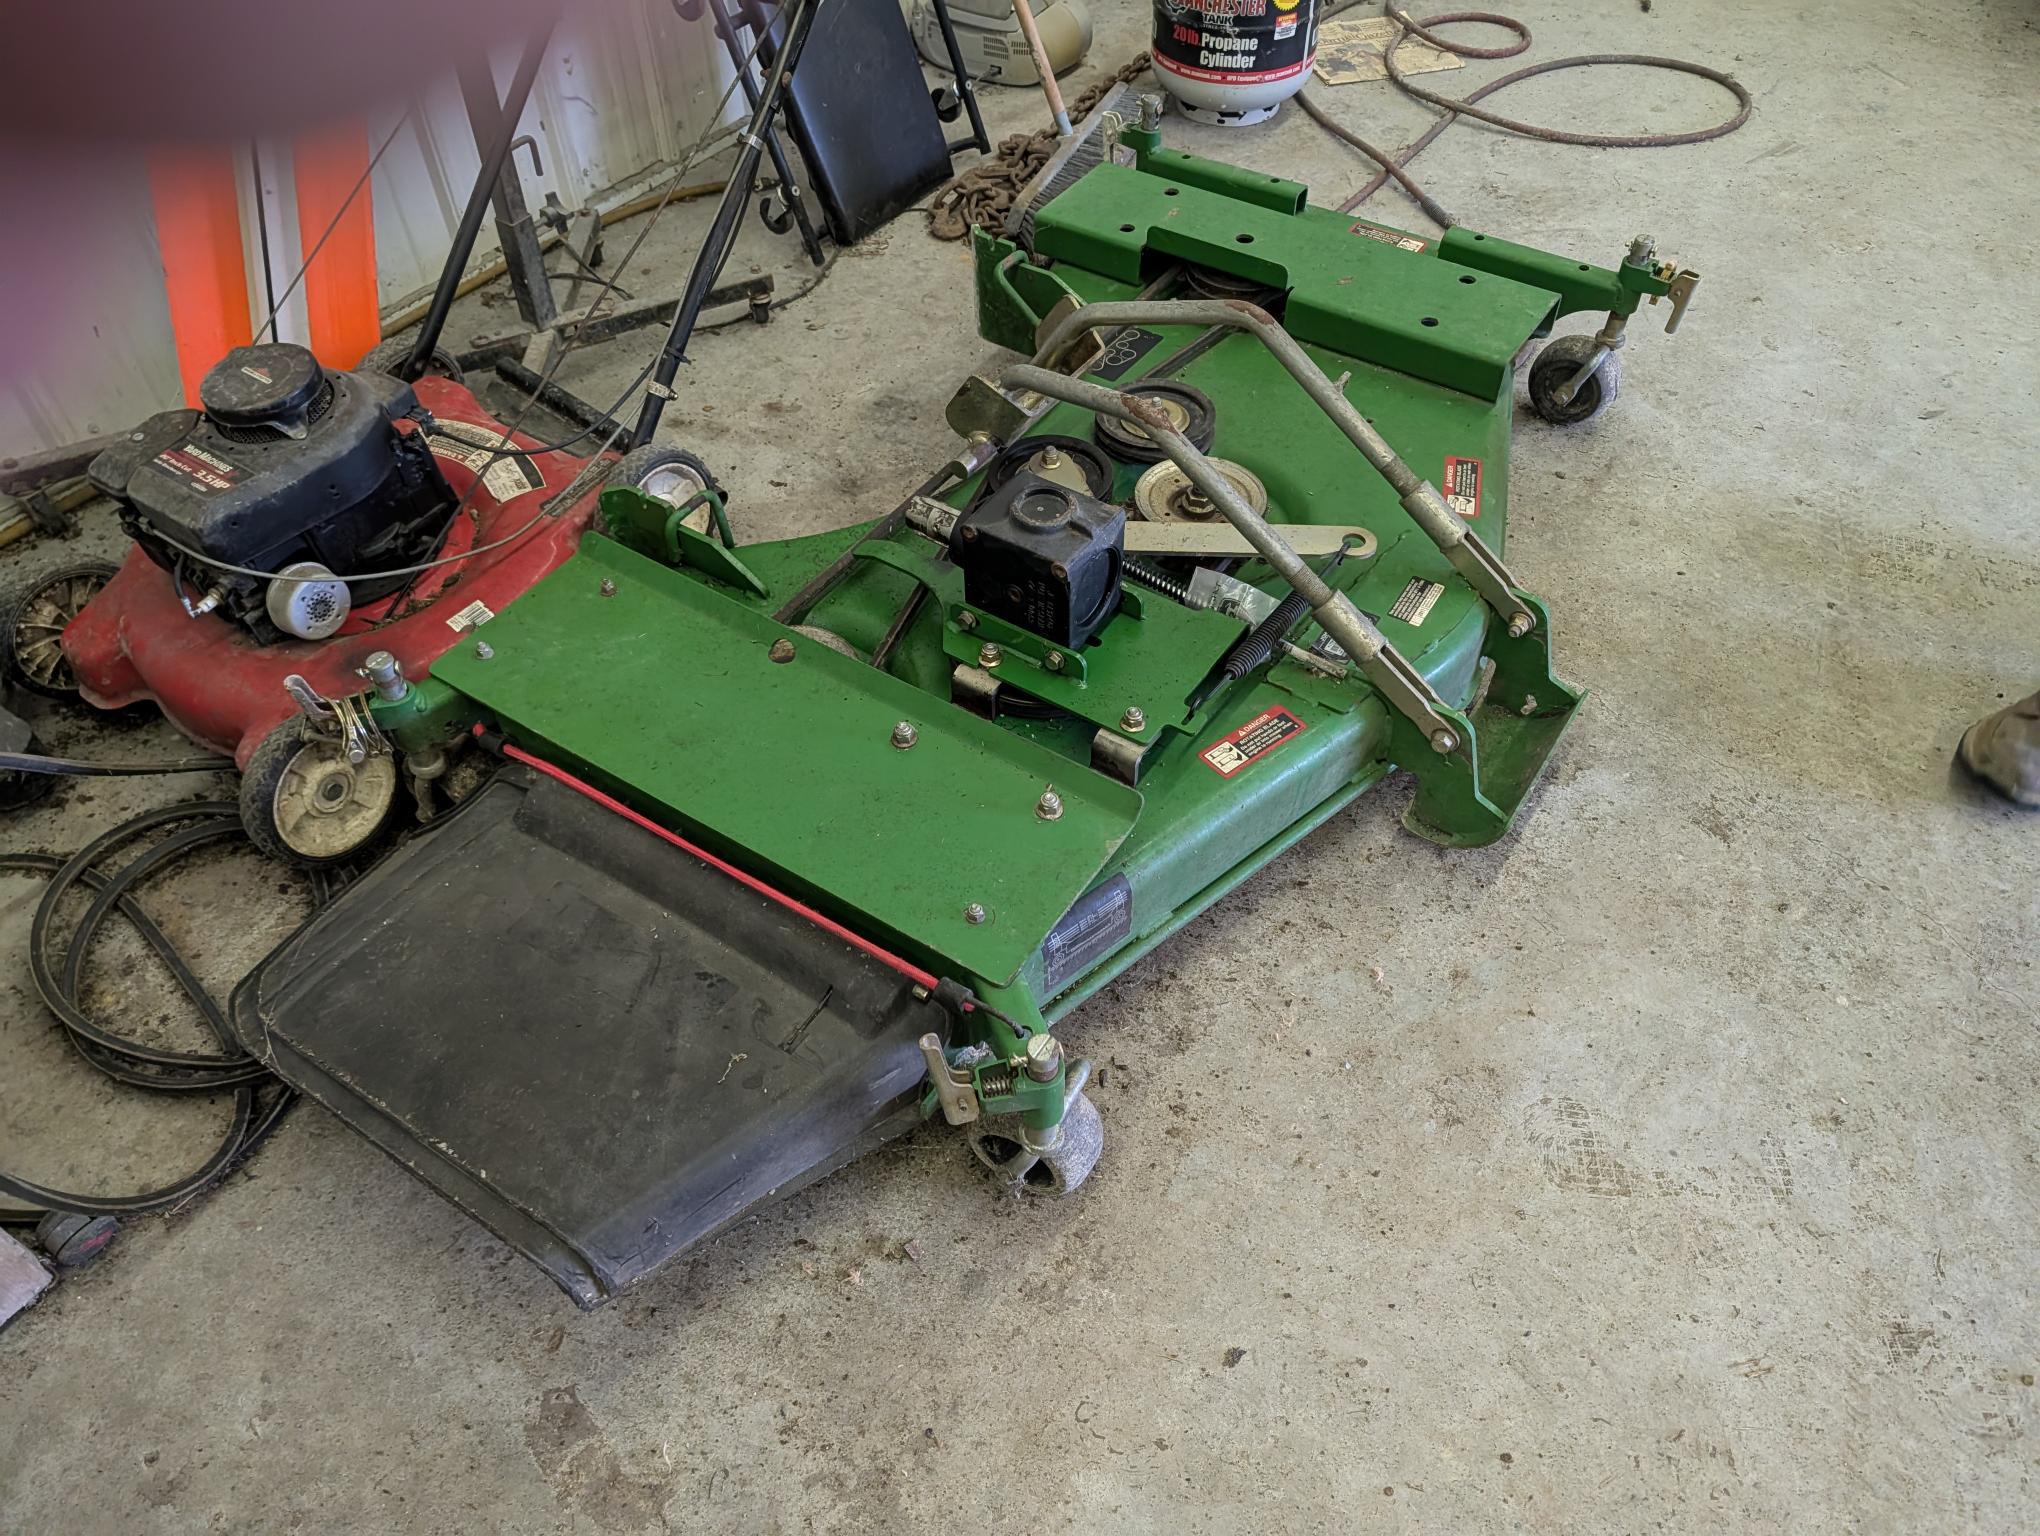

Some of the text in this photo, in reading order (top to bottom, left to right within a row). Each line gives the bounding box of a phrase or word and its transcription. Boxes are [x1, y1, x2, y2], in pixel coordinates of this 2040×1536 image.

[1202, 13, 1233, 26] TANK
[1201, 32, 1259, 52] Propane
[1200, 50, 1256, 68] Cylinder
[1446, 465, 1454, 483] DANGER
[209, 478, 231, 489] HP
[1239, 718, 1280, 745] ROTATING BLADE
[1243, 714, 1270, 732] DANGER
